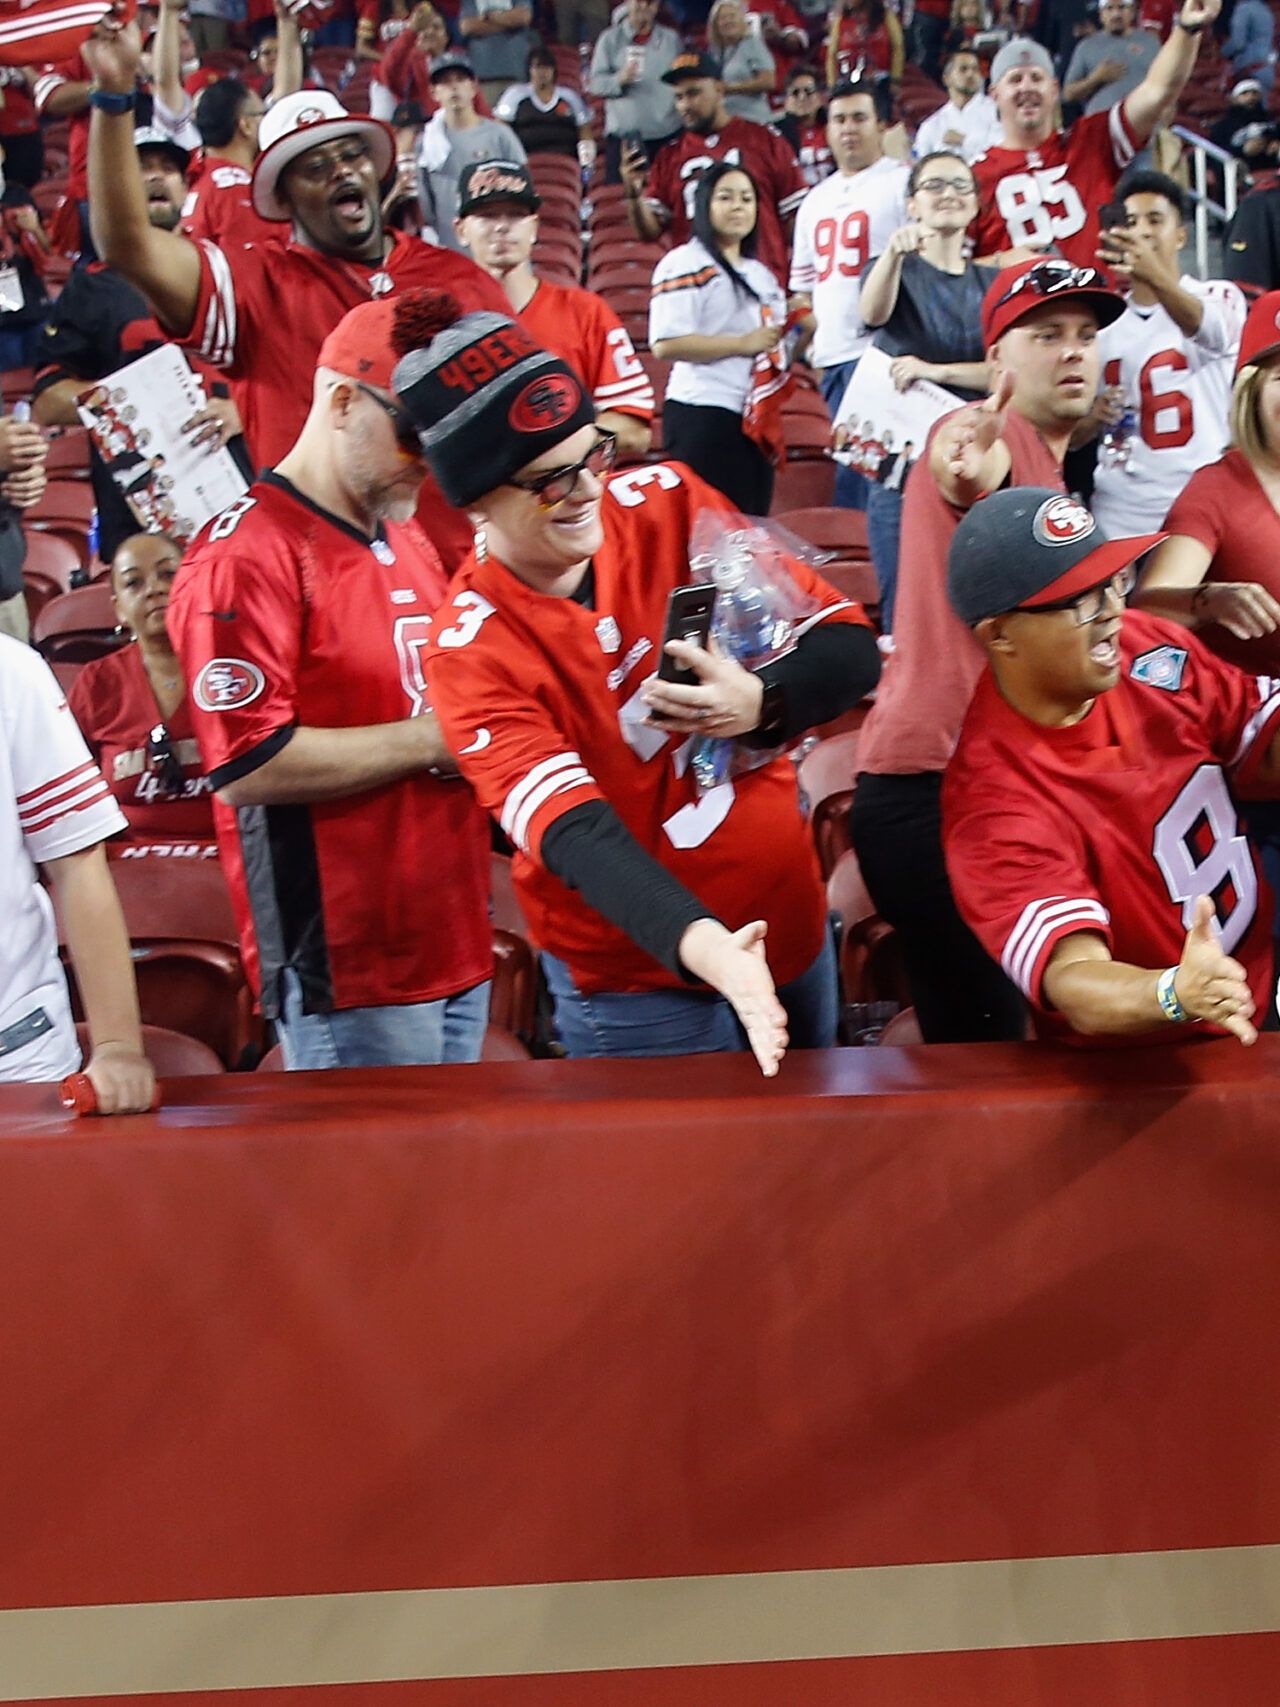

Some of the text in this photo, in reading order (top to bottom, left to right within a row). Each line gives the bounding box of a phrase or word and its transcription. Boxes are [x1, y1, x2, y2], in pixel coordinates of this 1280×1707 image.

[814, 210, 870, 283] 99
[995, 163, 1087, 249] 85
[1103, 347, 1195, 450] 6
[438, 590, 497, 648] 3
[1152, 763, 1258, 955] 8
